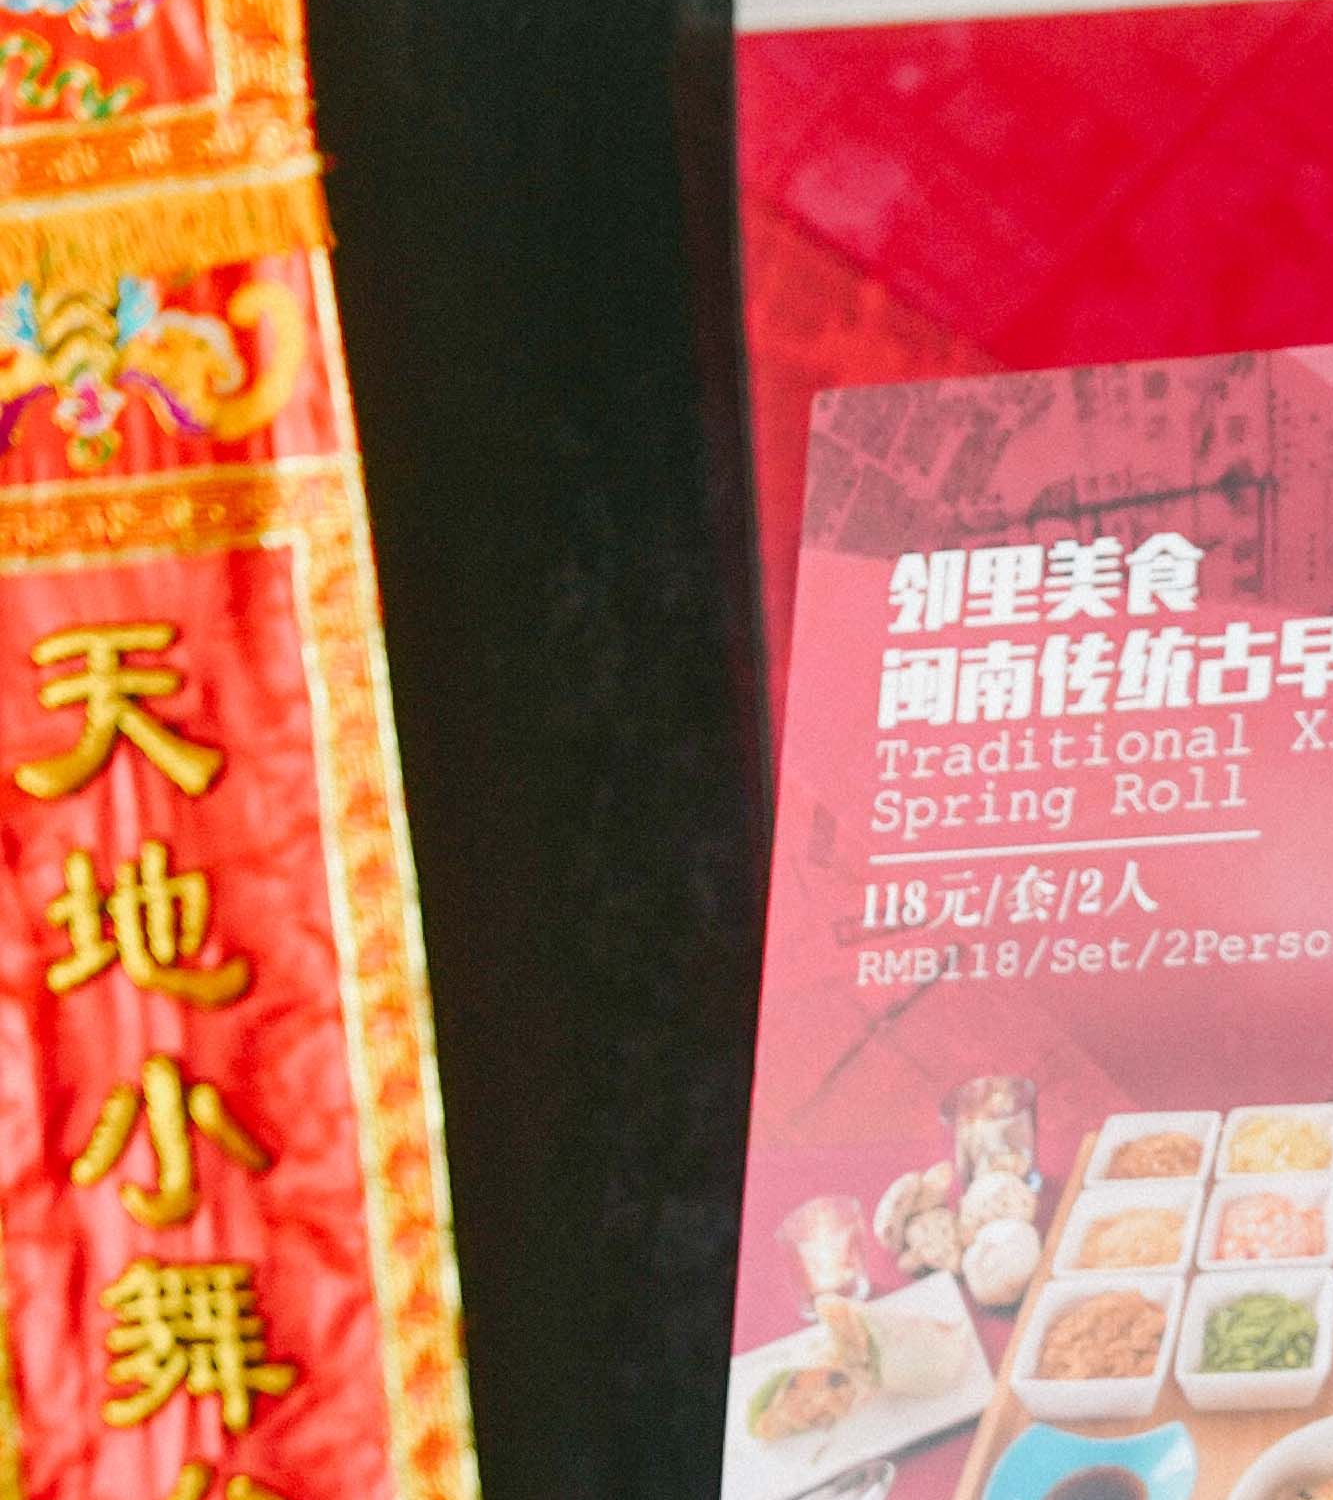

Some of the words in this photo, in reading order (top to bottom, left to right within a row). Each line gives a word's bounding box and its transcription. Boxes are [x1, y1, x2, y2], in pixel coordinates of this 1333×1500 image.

[888, 531, 1204, 634] 邻里美食
[875, 712, 1252, 781] Traditional
[870, 780, 1077, 841] Spring
[1110, 763, 1248, 817] Roll
